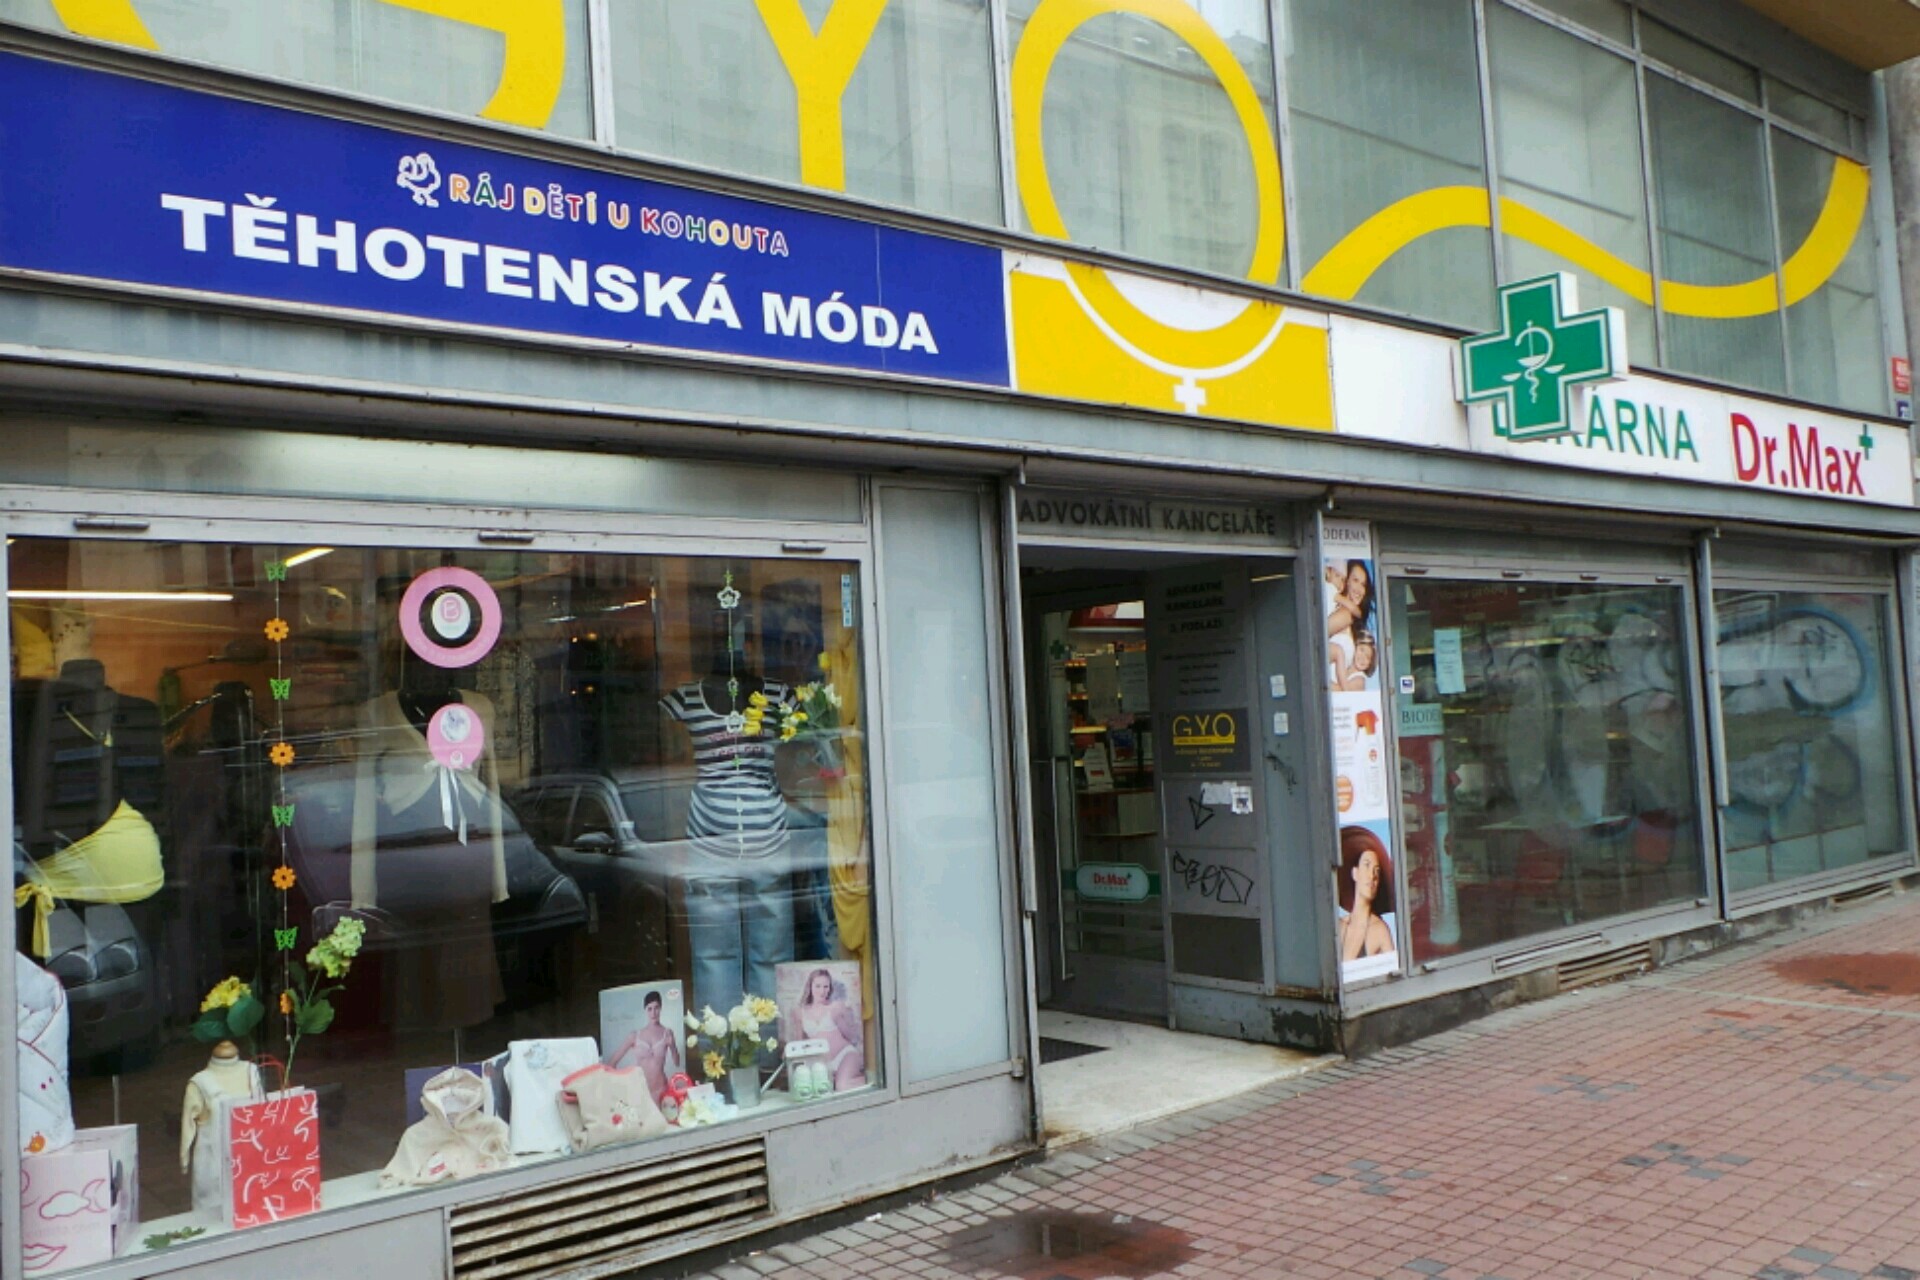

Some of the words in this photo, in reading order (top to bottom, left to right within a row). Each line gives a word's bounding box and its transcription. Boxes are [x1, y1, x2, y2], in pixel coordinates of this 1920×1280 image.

[449, 173, 515, 211] RÁJ
[523, 184, 598, 225] DĚTÍ
[607, 200, 631, 230] U
[640, 206, 790, 257] KOHOUTA
[160, 192, 742, 330] TĚHOTENSKÁ
[762, 291, 940, 356] MÓDA
[1491, 384, 1699, 463] LÁRNA
[1730, 412, 1866, 497] Dr.Max
[1019, 498, 1152, 529] ADVOKÁTNÍ
[1163, 507, 1276, 537] KANCELÁŘE
[1172, 712, 1236, 740] GYO
